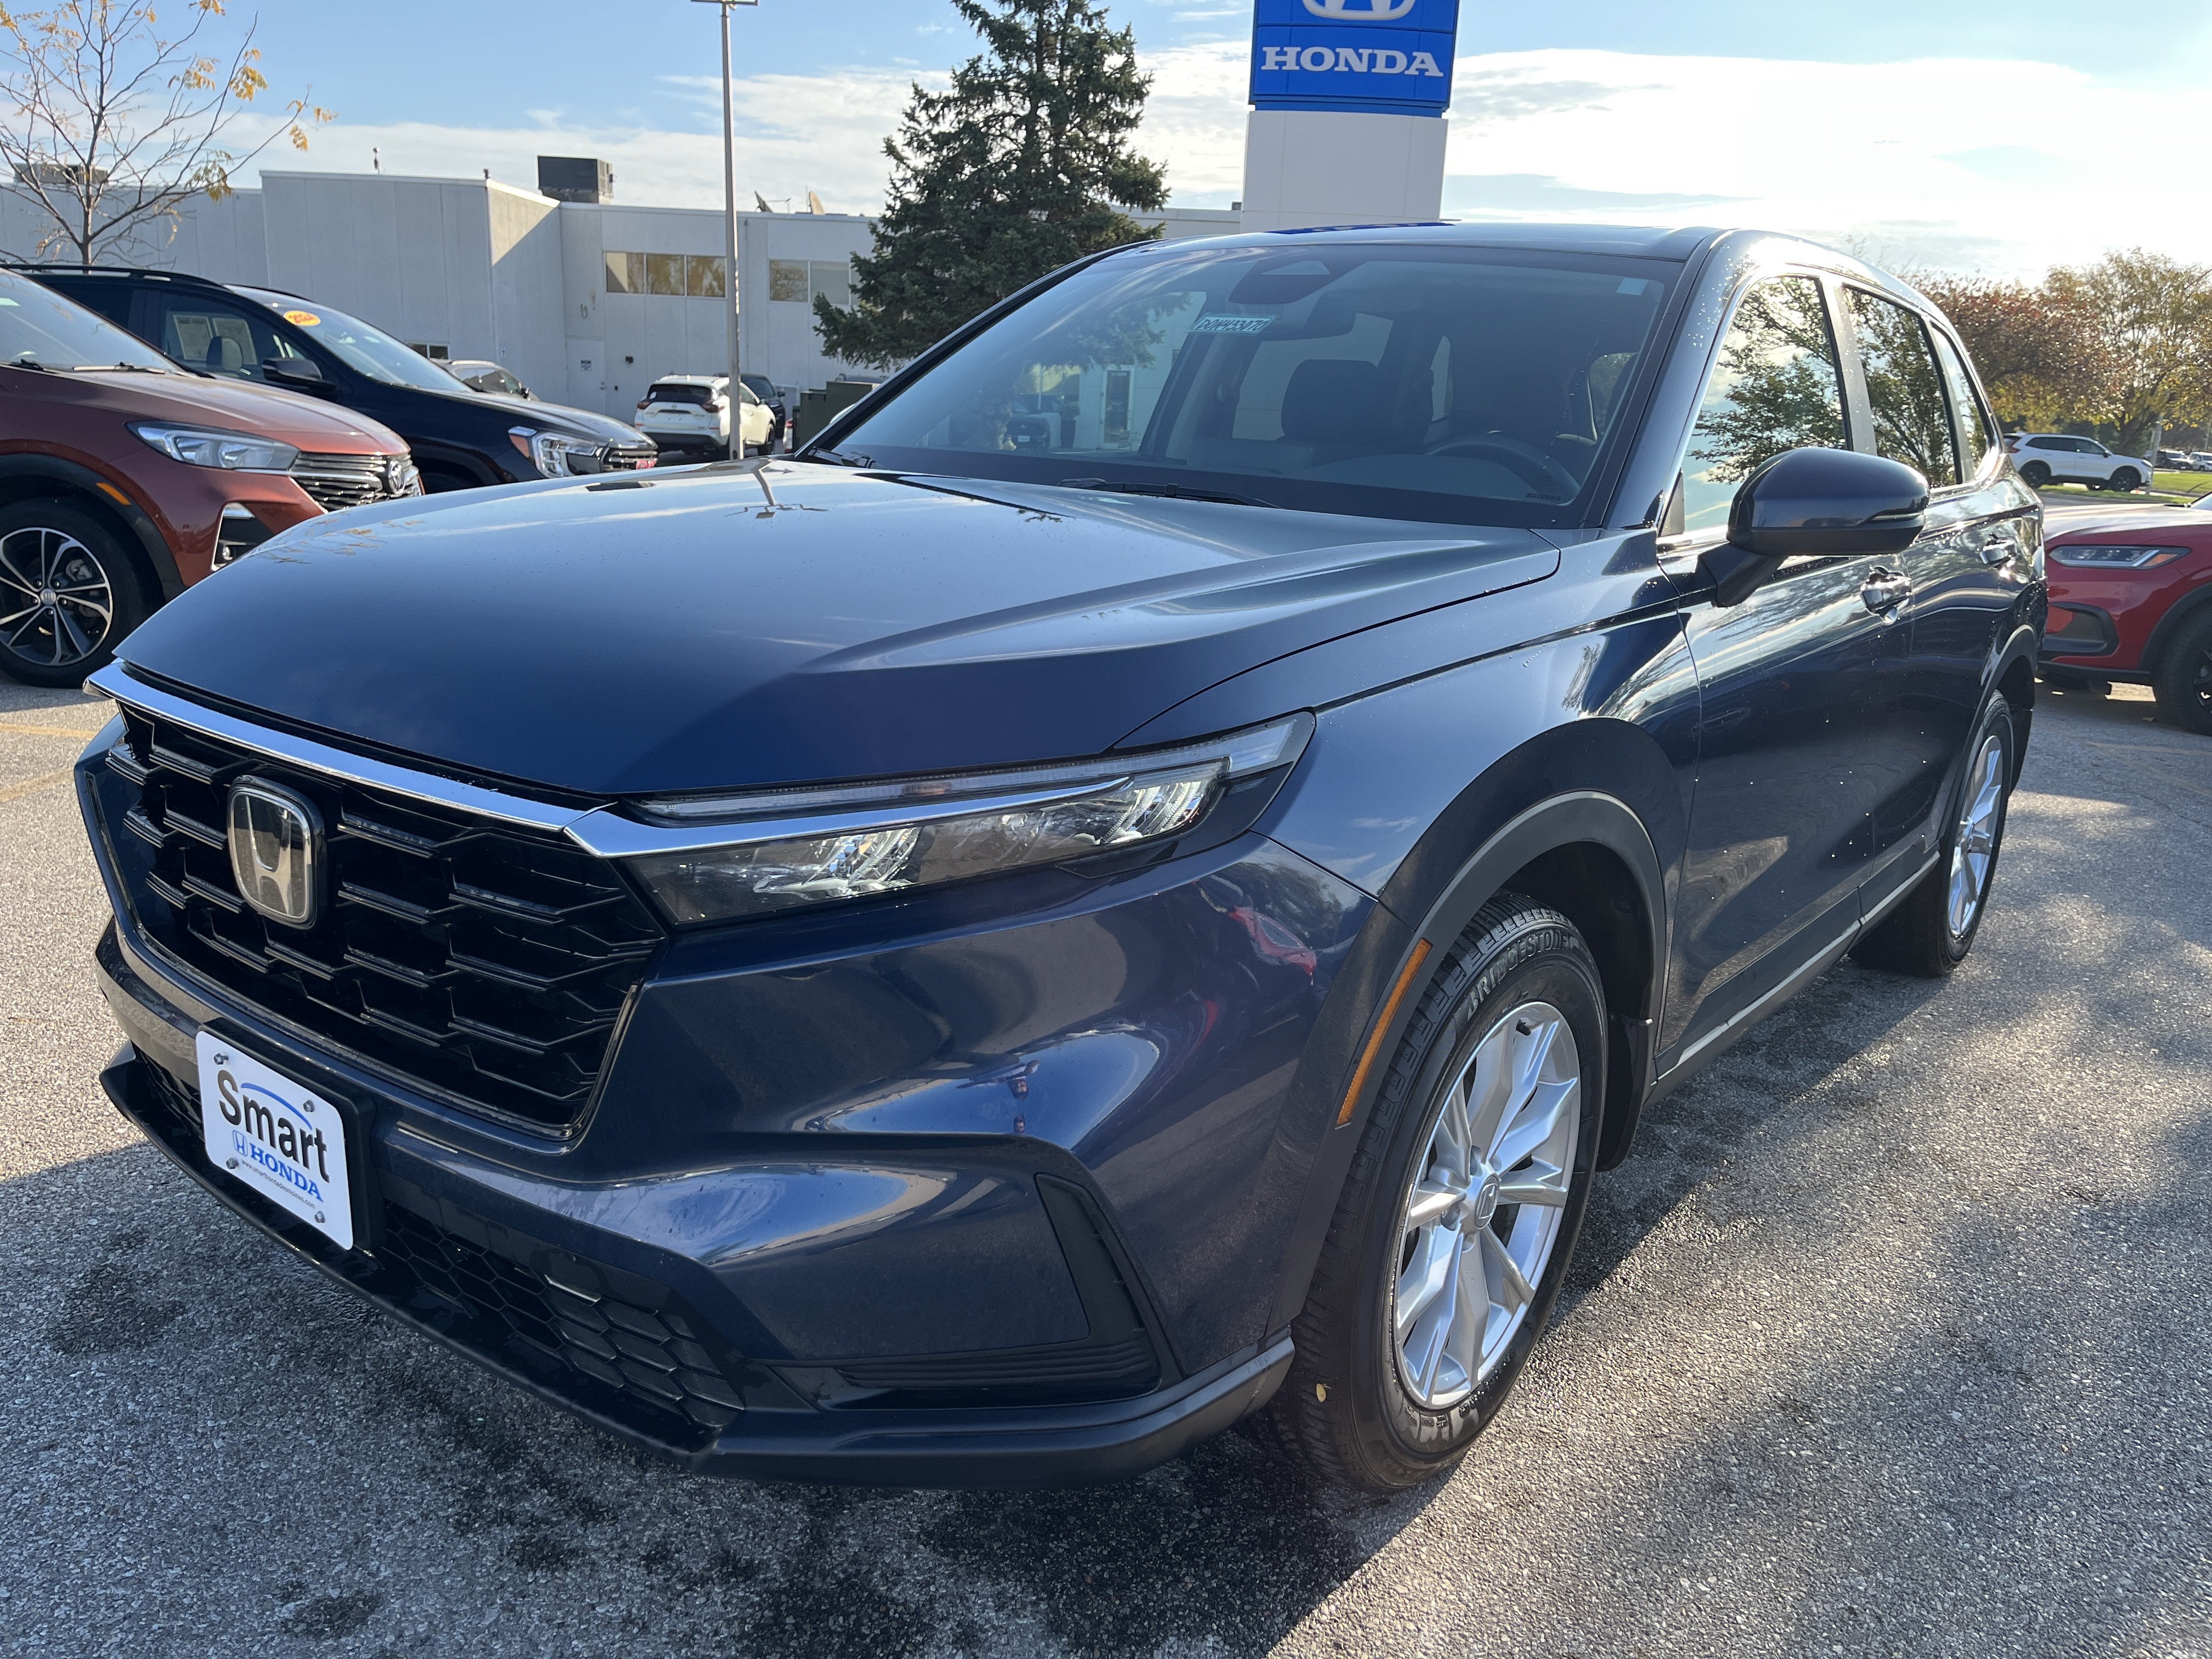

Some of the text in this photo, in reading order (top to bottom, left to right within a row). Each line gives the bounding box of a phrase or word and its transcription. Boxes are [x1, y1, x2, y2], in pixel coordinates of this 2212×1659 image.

[1261, 46, 1444, 77] HONDA
[1466, 929, 1570, 1022] BRIDGESTONE
[217, 1070, 330, 1183] Smart
[250, 1142, 324, 1203] HONDA
